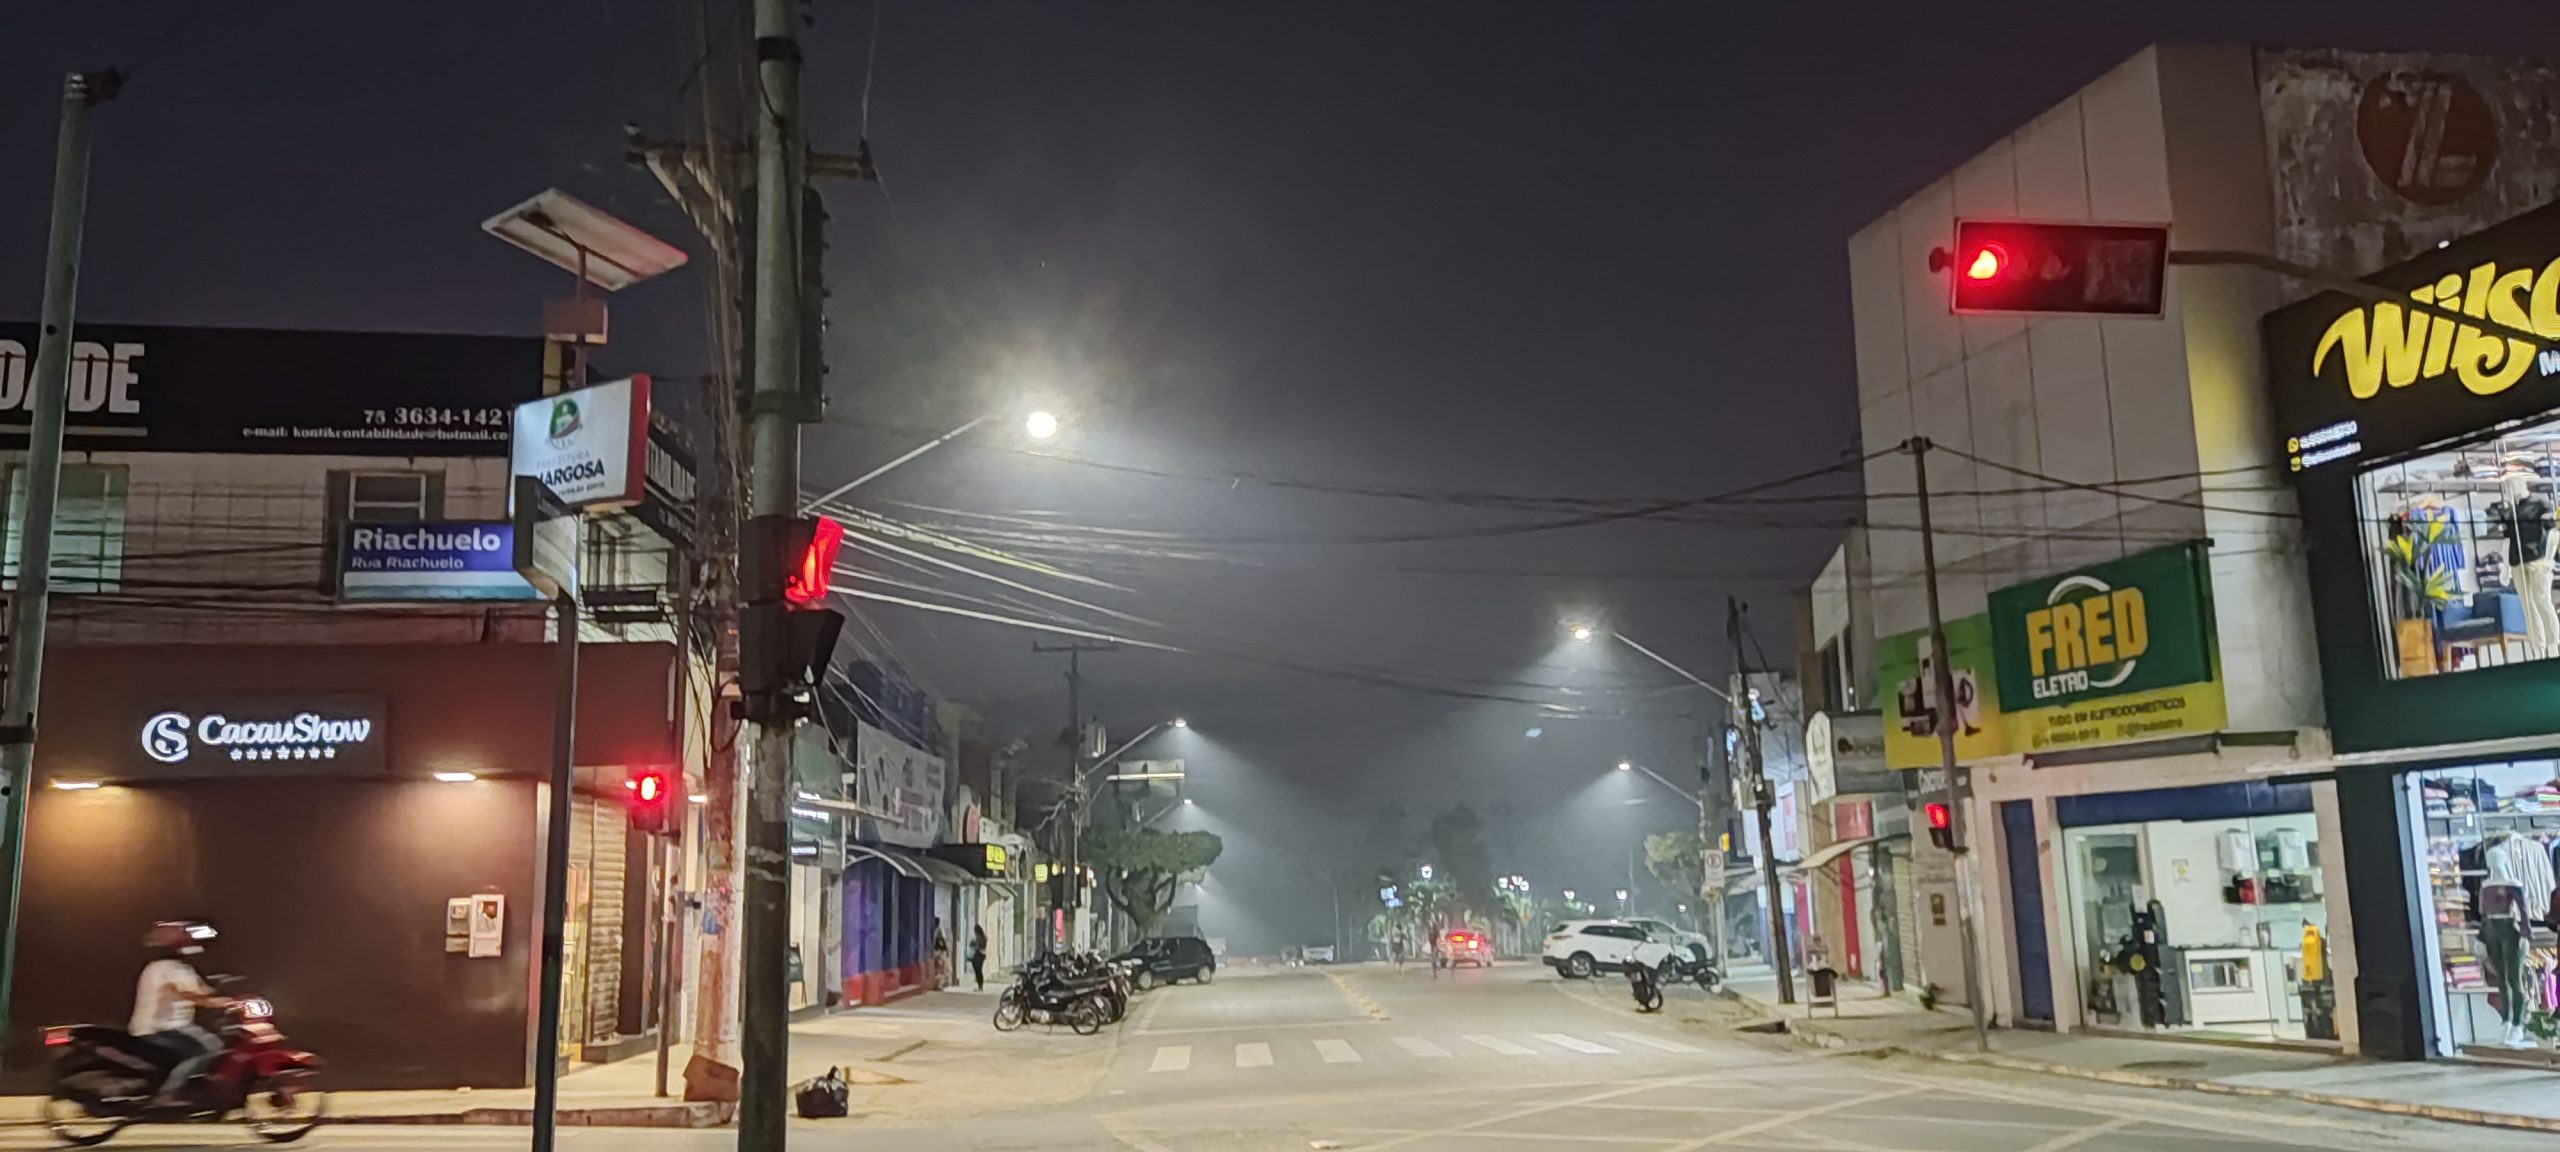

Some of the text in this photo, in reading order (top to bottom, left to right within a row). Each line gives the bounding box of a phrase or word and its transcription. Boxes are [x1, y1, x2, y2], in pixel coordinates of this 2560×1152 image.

[353, 527, 501, 551] Riachuelo
[352, 556, 464, 570] Rua Riachuelo
[2026, 586, 2149, 676] FRED
[2032, 671, 2089, 699] ELETRO
